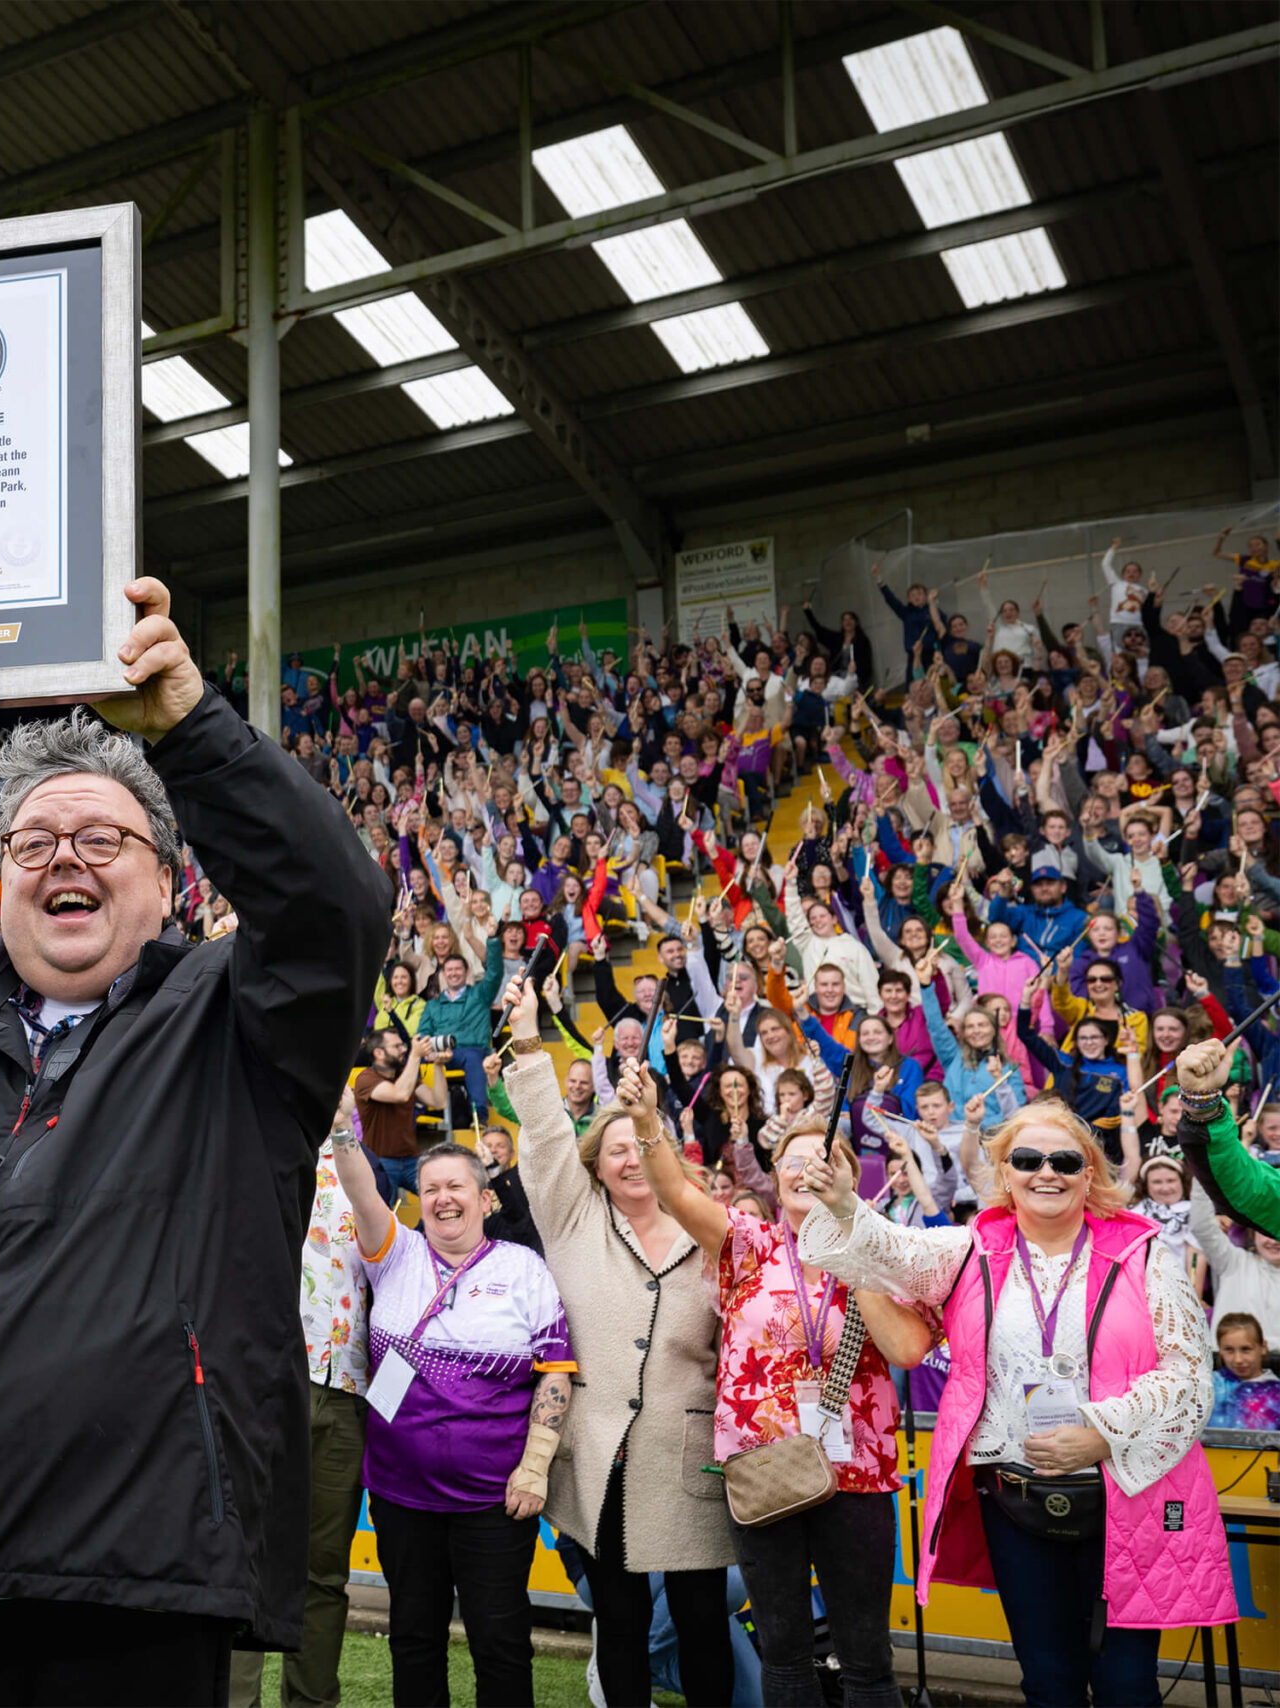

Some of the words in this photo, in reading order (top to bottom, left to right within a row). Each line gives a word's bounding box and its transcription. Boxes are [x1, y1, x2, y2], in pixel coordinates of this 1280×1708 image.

[11, 449, 27, 460] the
[1, 480, 27, 493] Park,
[681, 544, 744, 566] WEXFORD
